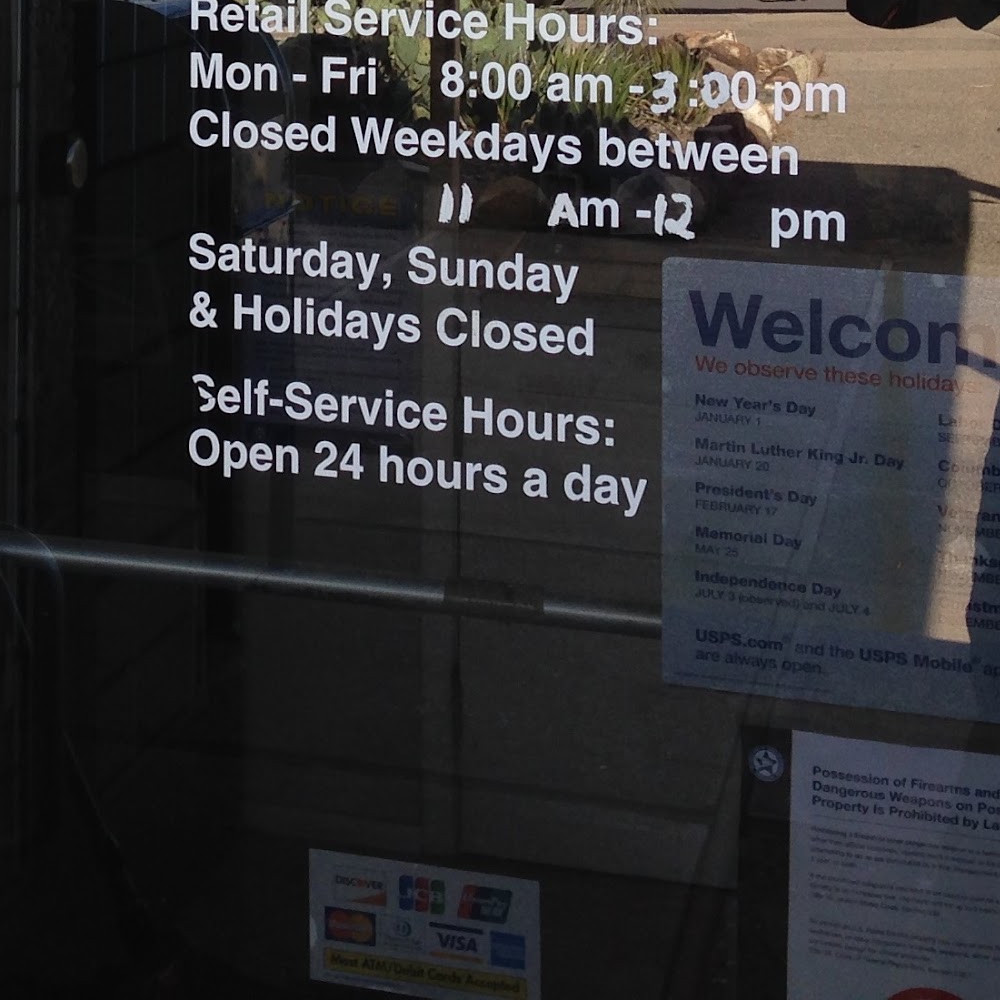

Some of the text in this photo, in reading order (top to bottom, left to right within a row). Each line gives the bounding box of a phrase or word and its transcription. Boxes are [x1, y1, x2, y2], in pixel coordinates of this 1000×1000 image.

[504, 4, 659, 47] Hours:
[189, 51, 278, 92] Mon
[321, 57, 376, 95] Fri
[440, 60, 532, 100] 8:00
[546, 73, 613, 103] am
[773, 79, 846, 122] pm
[189, 108, 799, 176] Closed Weekdays between
[548, 193, 619, 228] Am
[771, 206, 846, 249] pm
[189, 232, 579, 305] Saturday, Sunday
[189, 290, 595, 356] & Holidays Closed
[695, 355, 727, 375] We
[734, 360, 817, 381] observe
[823, 366, 881, 387] these
[192, 374, 615, 447] Self-Service Hours:
[695, 394, 816, 417] New Year's Day
[695, 412, 751, 426] JANUARY
[695, 437, 746, 453] Martin
[751, 443, 803, 458] Luther
[807, 448, 843, 465] King
[874, 453, 905, 470] Day
[695, 456, 752, 469] JANUARY
[188, 428, 648, 518] Open 24 hours a day
[695, 481, 817, 507] President's Day
[695, 500, 761, 515] FEBRUARY
[695, 526, 802, 550] Memorial Day
[695, 570, 841, 598] Independence Day
[695, 650, 720, 663] are
[724, 655, 777, 671] always
[795, 641, 825, 657] and
[829, 645, 855, 660] the
[859, 647, 908, 666] USPS
[812, 780, 886, 800] Dangerous
[889, 791, 952, 809] Weapons
[955, 801, 973, 812] on
[813, 766, 889, 786] Possession
[893, 777, 907, 788] of
[911, 778, 970, 796] Firearms
[812, 795, 869, 814] Property
[889, 806, 959, 826] Prohibited
[963, 815, 979, 830] by
[436, 931, 479, 953] VISA
